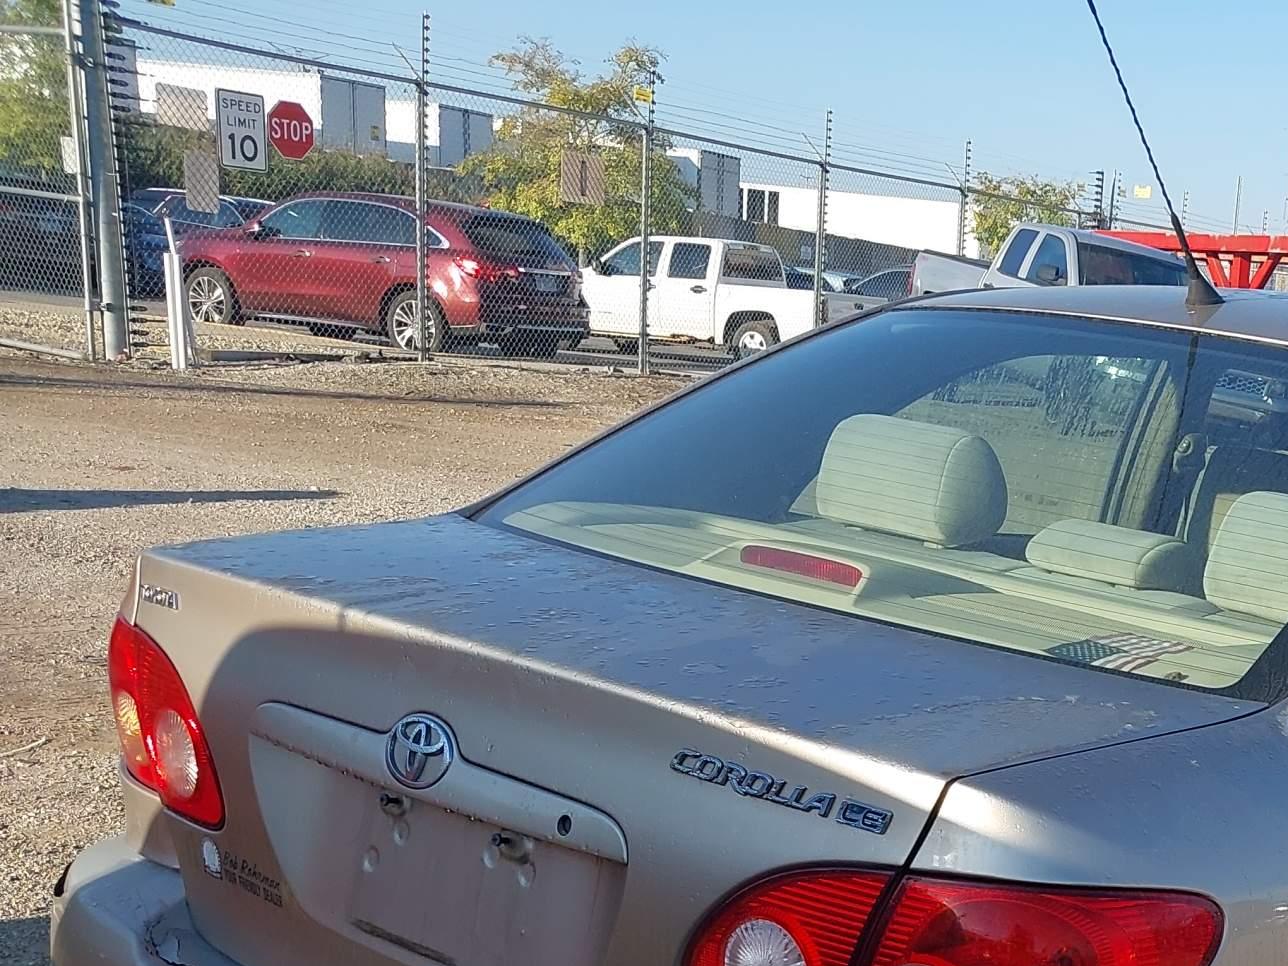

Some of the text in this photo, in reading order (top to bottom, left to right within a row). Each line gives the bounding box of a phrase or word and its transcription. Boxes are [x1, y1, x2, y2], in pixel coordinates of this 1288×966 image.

[221, 98, 261, 114] SPEED
[226, 115, 257, 130] LIMIT
[271, 117, 312, 142] STOP
[228, 132, 258, 162] 10
[670, 748, 837, 818] COROLLA
